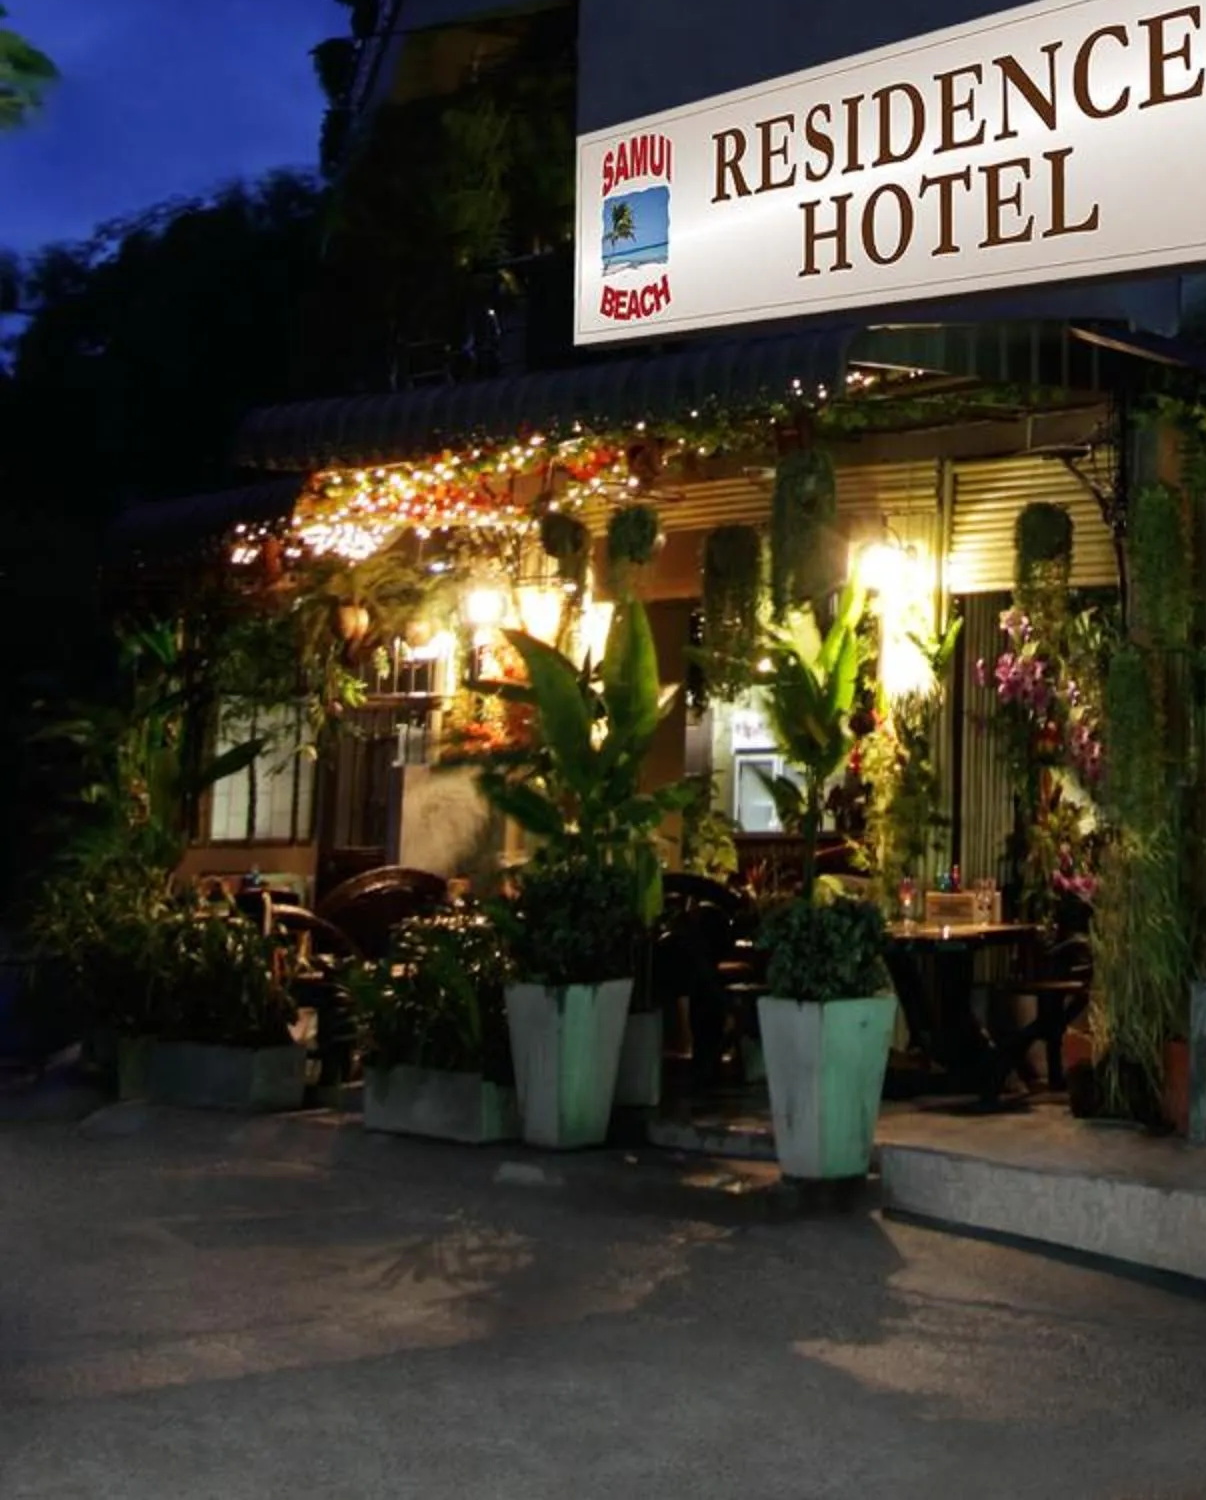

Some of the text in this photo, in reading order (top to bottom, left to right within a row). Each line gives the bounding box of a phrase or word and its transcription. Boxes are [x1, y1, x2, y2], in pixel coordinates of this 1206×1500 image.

[711, 5, 1206, 204] RESIDENCE
[602, 134, 672, 197] SAMUI
[798, 147, 1099, 278] HOTEL
[600, 274, 672, 321] BEACH
